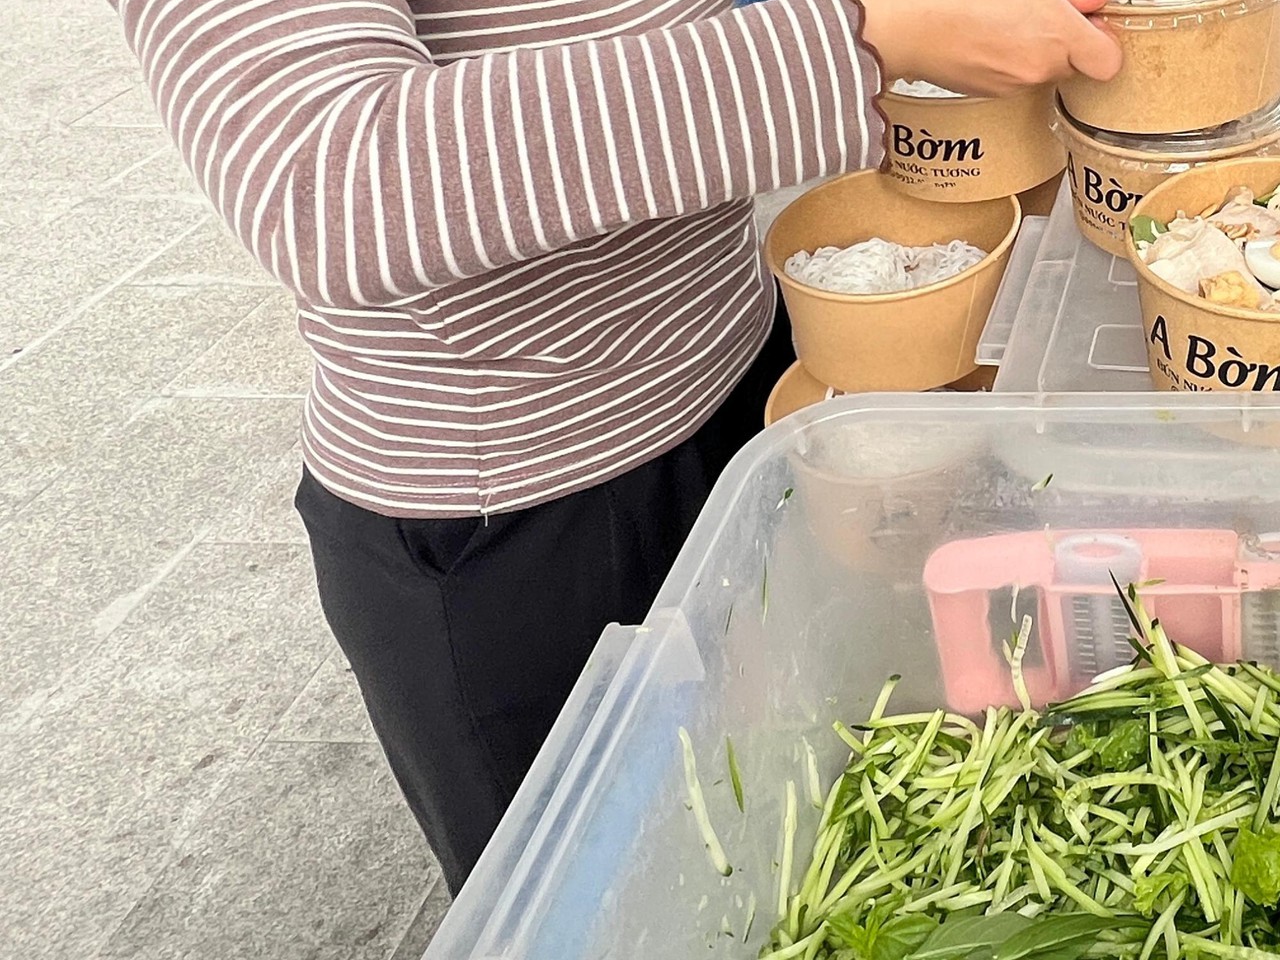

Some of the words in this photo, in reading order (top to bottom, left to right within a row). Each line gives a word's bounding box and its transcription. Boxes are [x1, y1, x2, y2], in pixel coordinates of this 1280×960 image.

[892, 124, 985, 162] Bờm
[930, 167, 981, 178] TƯƠNG
[1150, 315, 1172, 360] A
